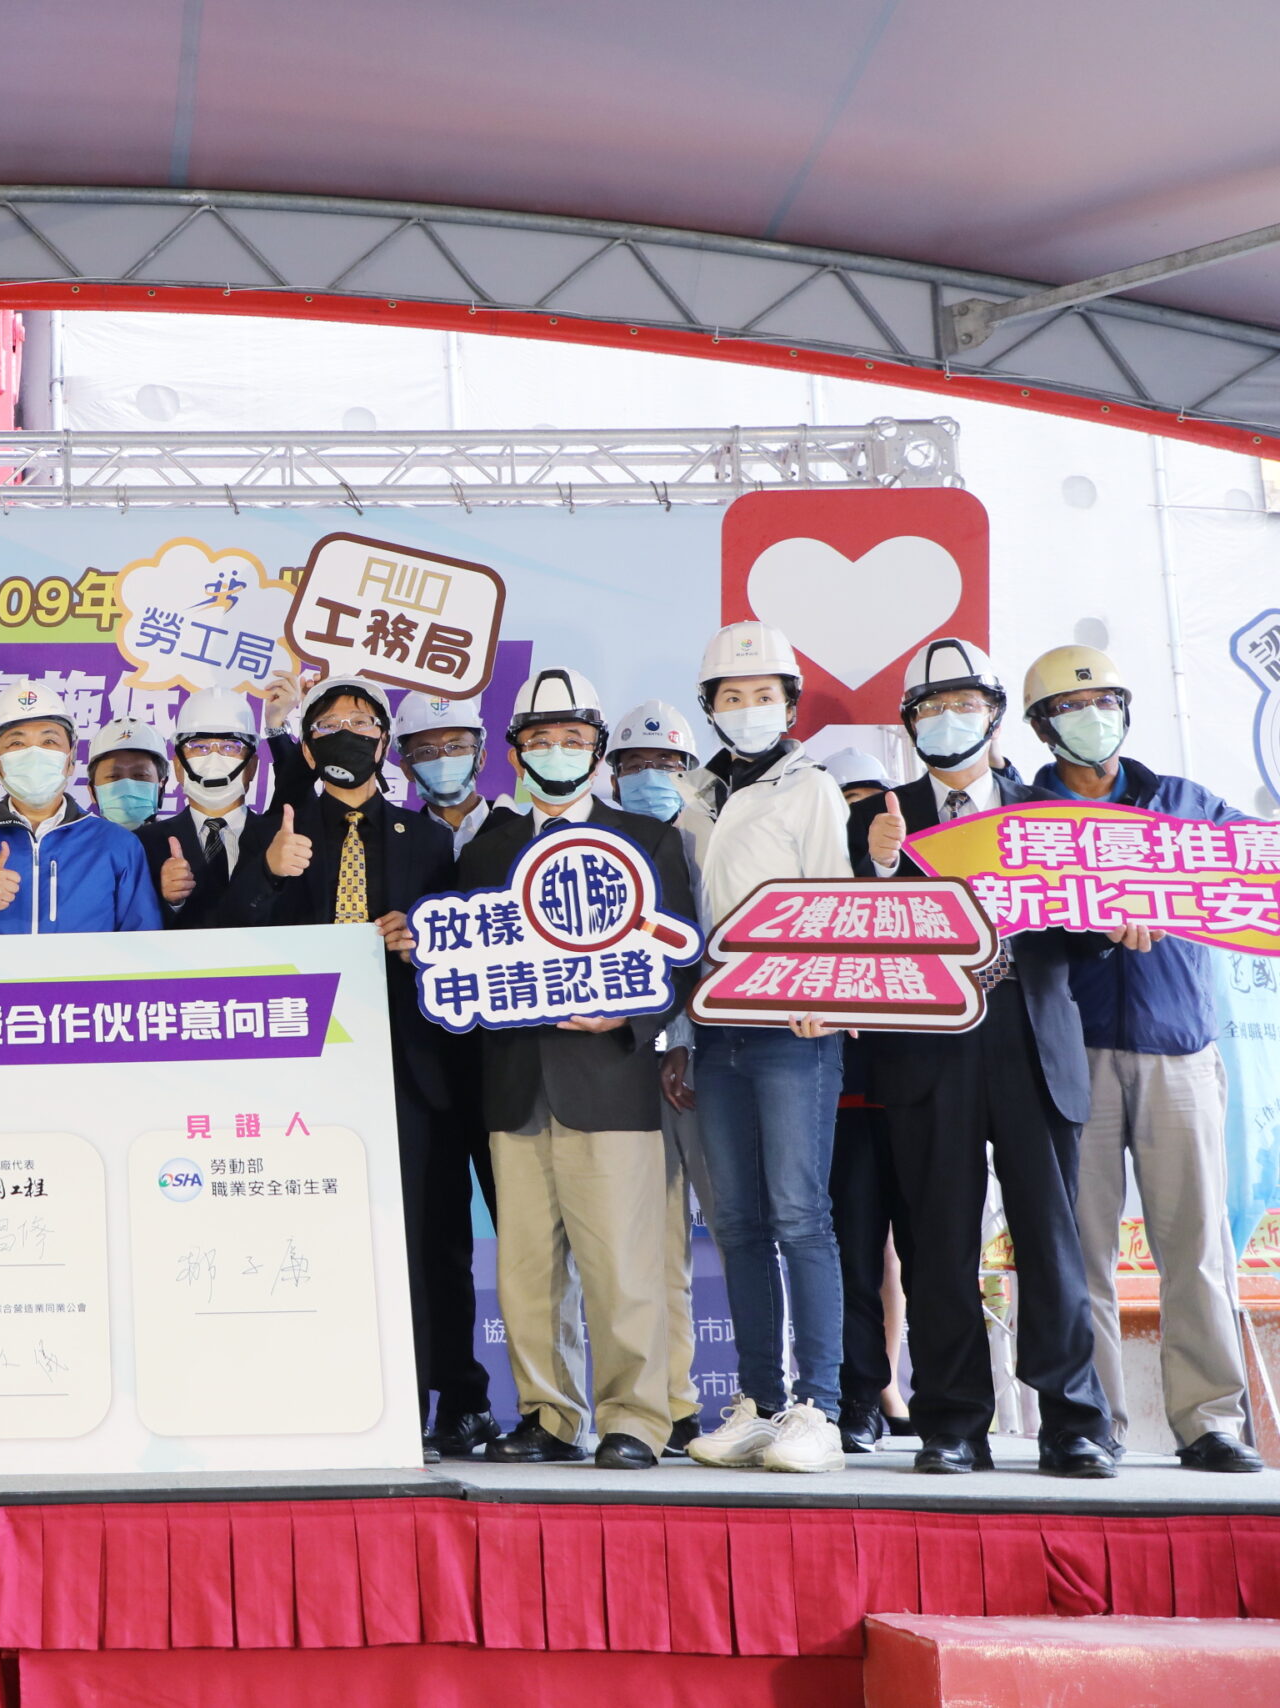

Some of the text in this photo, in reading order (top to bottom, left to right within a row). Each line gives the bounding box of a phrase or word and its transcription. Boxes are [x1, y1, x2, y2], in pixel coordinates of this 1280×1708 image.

[136, 606, 276, 680] 勞工局
[305, 597, 473, 680] 工務局
[1003, 819, 1280, 872] 擇優推薦
[424, 854, 628, 952] 放樣 勘驗
[971, 875, 1279, 931] 新北工安
[434, 949, 657, 1016] 申請認證
[734, 955, 937, 1001] 取得認證
[187, 1112, 310, 1139] 見證人
[210, 1157, 264, 1175] 勞動部
[211, 1178, 339, 1198] 職業安全衛生署
